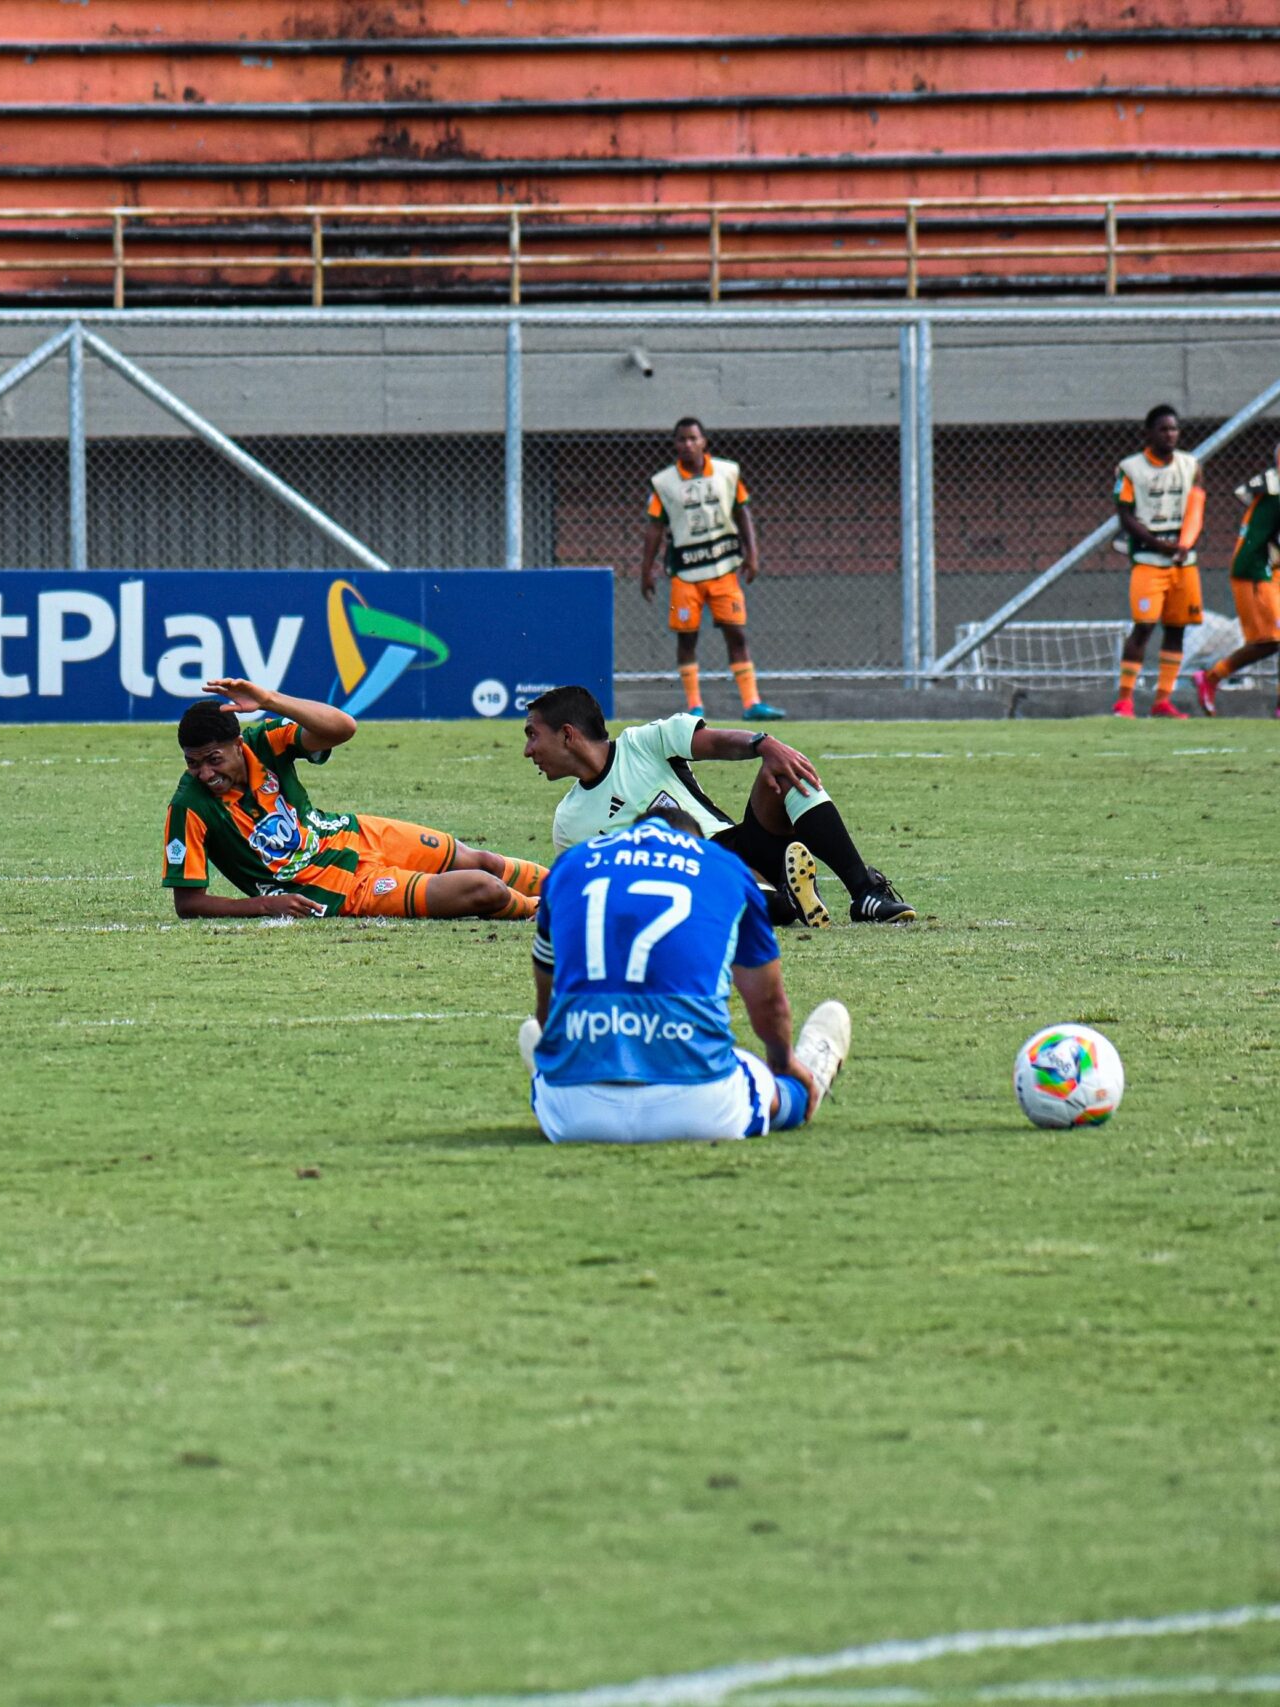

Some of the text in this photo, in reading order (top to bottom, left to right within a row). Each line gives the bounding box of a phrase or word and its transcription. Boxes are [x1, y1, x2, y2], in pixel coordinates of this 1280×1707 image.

[479, 693, 500, 704] +18
[585, 849, 700, 877] J. ARIAS
[582, 877, 693, 983] 17
